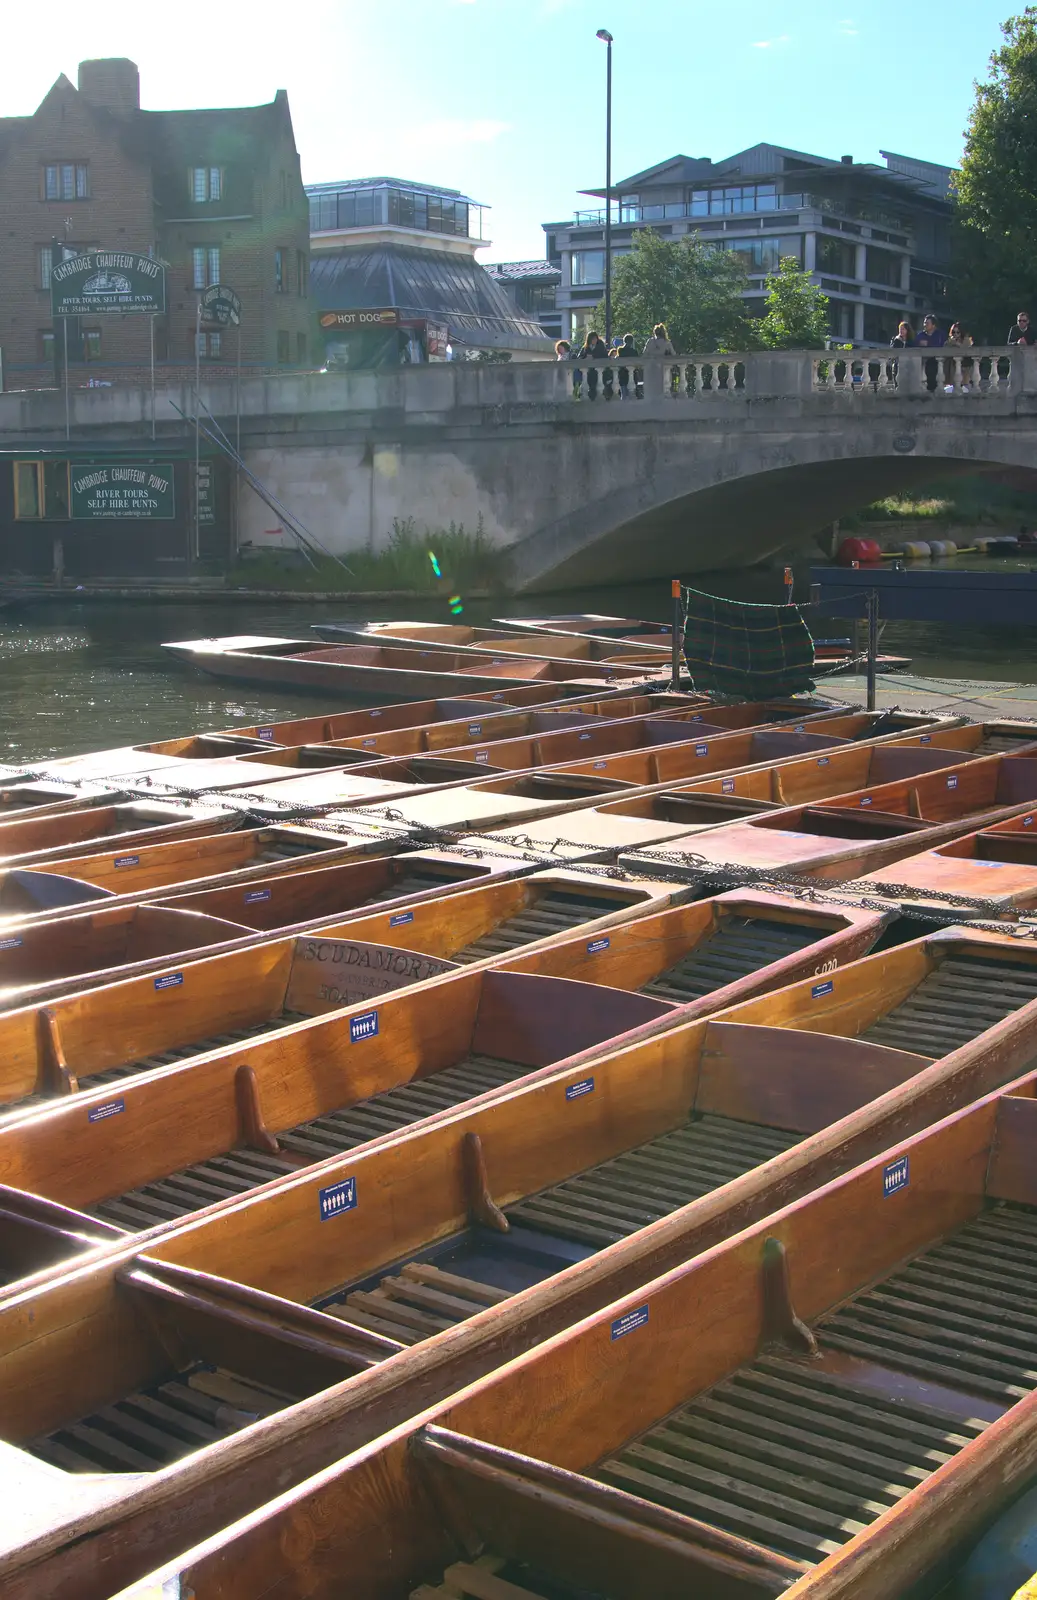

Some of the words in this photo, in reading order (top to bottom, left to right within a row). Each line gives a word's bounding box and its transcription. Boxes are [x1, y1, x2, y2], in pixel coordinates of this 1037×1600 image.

[53, 257, 92, 281] CAMBRIDGE
[96, 254, 134, 269] CHAUFFEUR
[137, 259, 160, 278] PUNTS
[337, 314, 356, 324] HOT
[359, 313, 381, 323] DOG
[437, 331, 447, 341] DOG
[73, 470, 108, 494] CAMBRIDGE
[111, 468, 146, 484] CHAUFFEUR
[147, 474, 169, 493] PUNTS
[96, 489, 120, 499] RIVER
[122, 489, 149, 498] TOURS
[87, 499, 107, 508] SELF
[109, 499, 130, 508] HIRE
[132, 499, 158, 508] PUNTS
